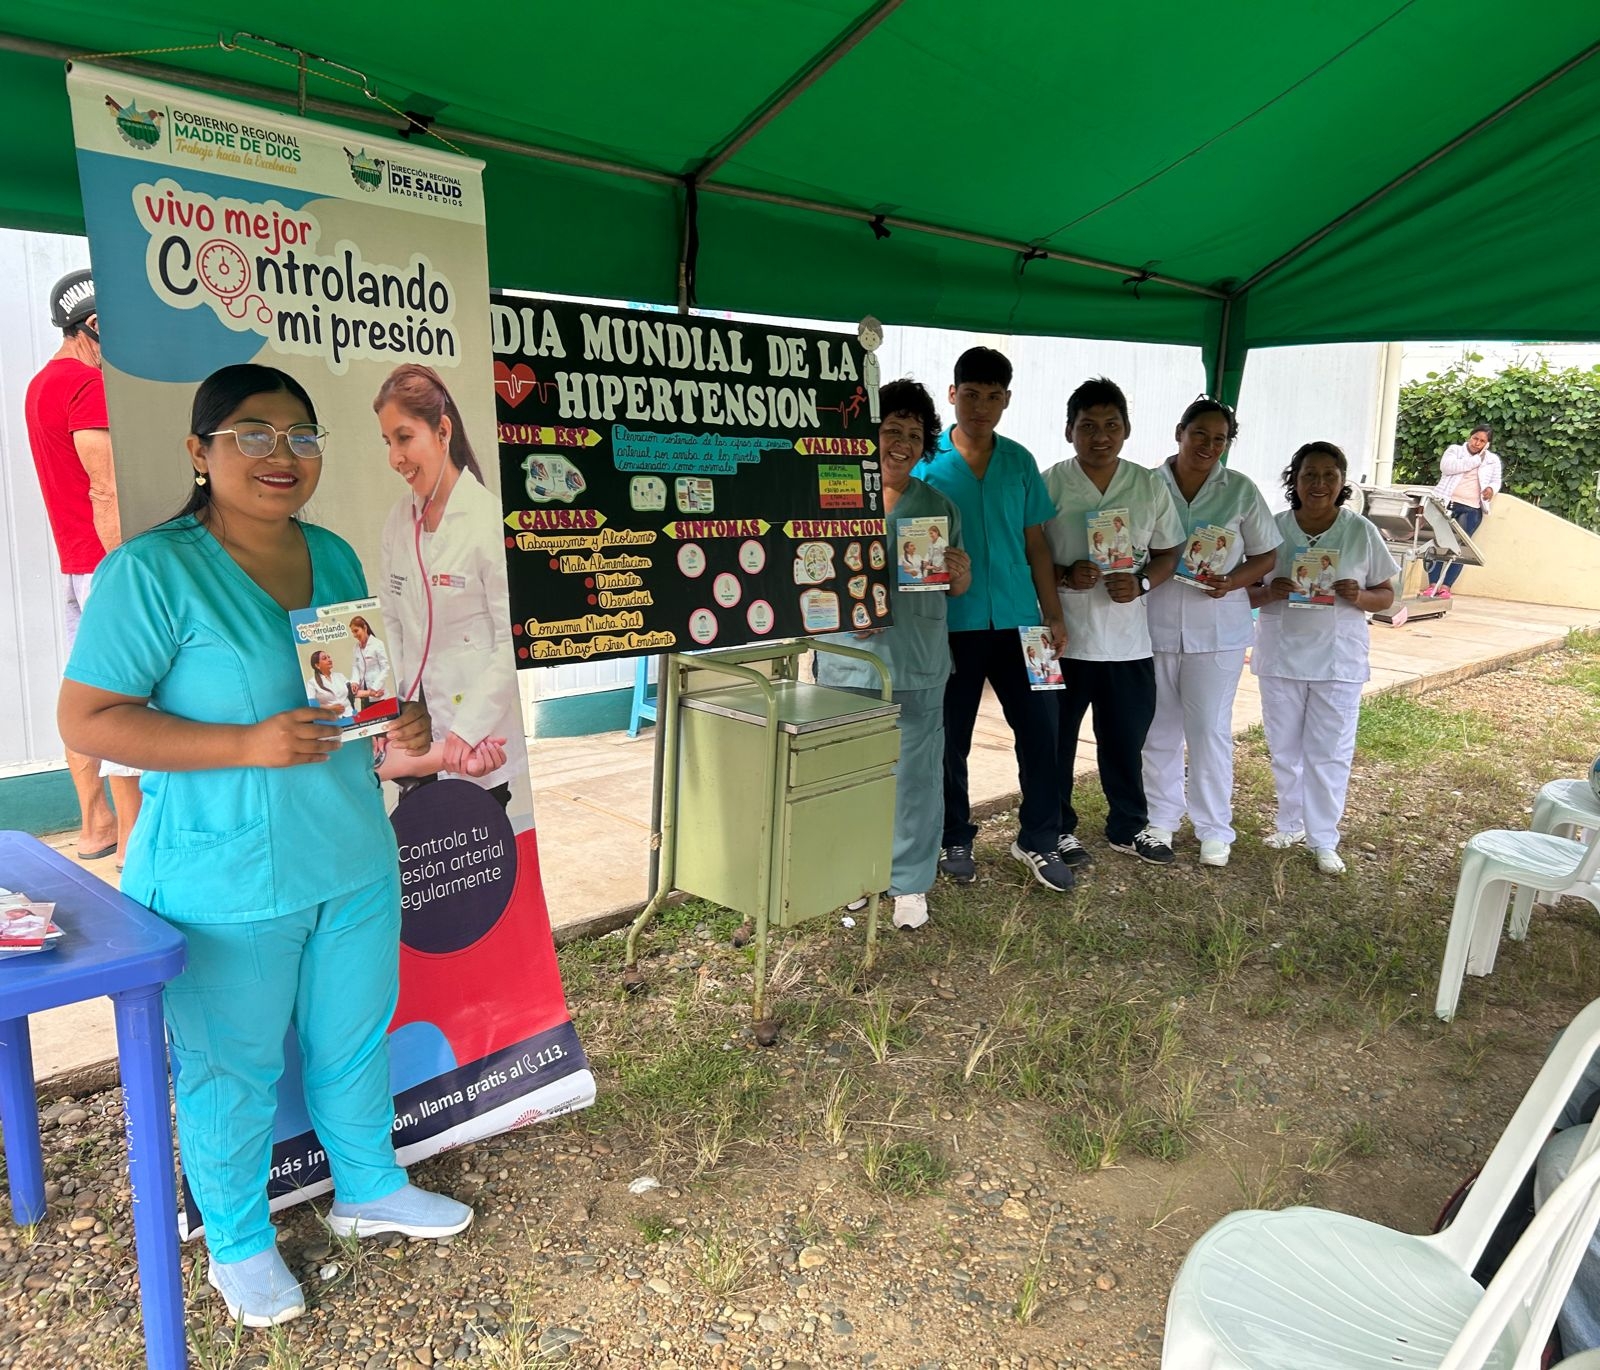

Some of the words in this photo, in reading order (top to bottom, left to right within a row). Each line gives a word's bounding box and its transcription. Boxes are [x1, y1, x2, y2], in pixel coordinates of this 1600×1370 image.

[173, 110, 239, 134] GOBIERNO
[241, 125, 300, 148] REGIONAL
[174, 123, 236, 148] MADRE
[240, 137, 261, 153] DE
[265, 142, 302, 162] DIOS
[175, 138, 213, 161] Trabajo
[216, 146, 241, 163] hacia
[243, 154, 252, 166] la
[255, 155, 297, 174] Excelencia
[391, 164, 428, 178] DIRECCIÓN
[429, 173, 461, 186] REGIONAL
[392, 172, 412, 188] DE
[415, 178, 462, 198] SALUD
[392, 187, 423, 199] MADRE
[428, 194, 439, 202] DE
[443, 197, 463, 207] DIOS
[145, 190, 214, 231] vivo
[224, 207, 312, 255] mejor
[277, 304, 322, 345] mi
[331, 313, 455, 363] presión
[490, 304, 567, 358] DIA
[580, 313, 752, 374] MUNDIAL
[766, 335, 809, 379] DE
[817, 340, 859, 381] LA
[555, 371, 820, 428] HIPERTENSION
[553, 425, 590, 448] ES?
[702, 435, 712, 446] de
[802, 437, 869, 455] VALORES
[617, 445, 651, 458] arterial
[653, 450, 669, 460] por
[672, 448, 700, 460] arriba
[703, 451, 713, 461] de
[719, 448, 730, 461] los
[698, 461, 734, 472] normales
[518, 509, 598, 530] CAUSAS
[674, 519, 761, 538] SINTOMAS
[792, 519, 883, 538] PREVENCION
[518, 534, 588, 553] Tabaquismo
[591, 537, 599, 551] y
[602, 529, 656, 545] Alcolismo
[561, 557, 587, 572] Mala
[597, 573, 642, 588] Diabetes
[600, 591, 653, 607] Obesidad
[527, 620, 582, 636] Consumir
[585, 616, 617, 632] Mucha
[620, 612, 642, 628] Sal
[531, 643, 562, 658] Estar
[564, 639, 592, 658] Bajo
[593, 637, 625, 652] Estres
[628, 632, 676, 648] Constante
[398, 830, 468, 863] Controla
[471, 826, 489, 842] tu
[400, 860, 446, 885] esión
[450, 840, 504, 871] arterial
[400, 867, 502, 911] egularmente
[419, 1089, 464, 1119] llama
[466, 1071, 508, 1102] gratis
[510, 1060, 524, 1079] al
[536, 1044, 568, 1067] 113.
